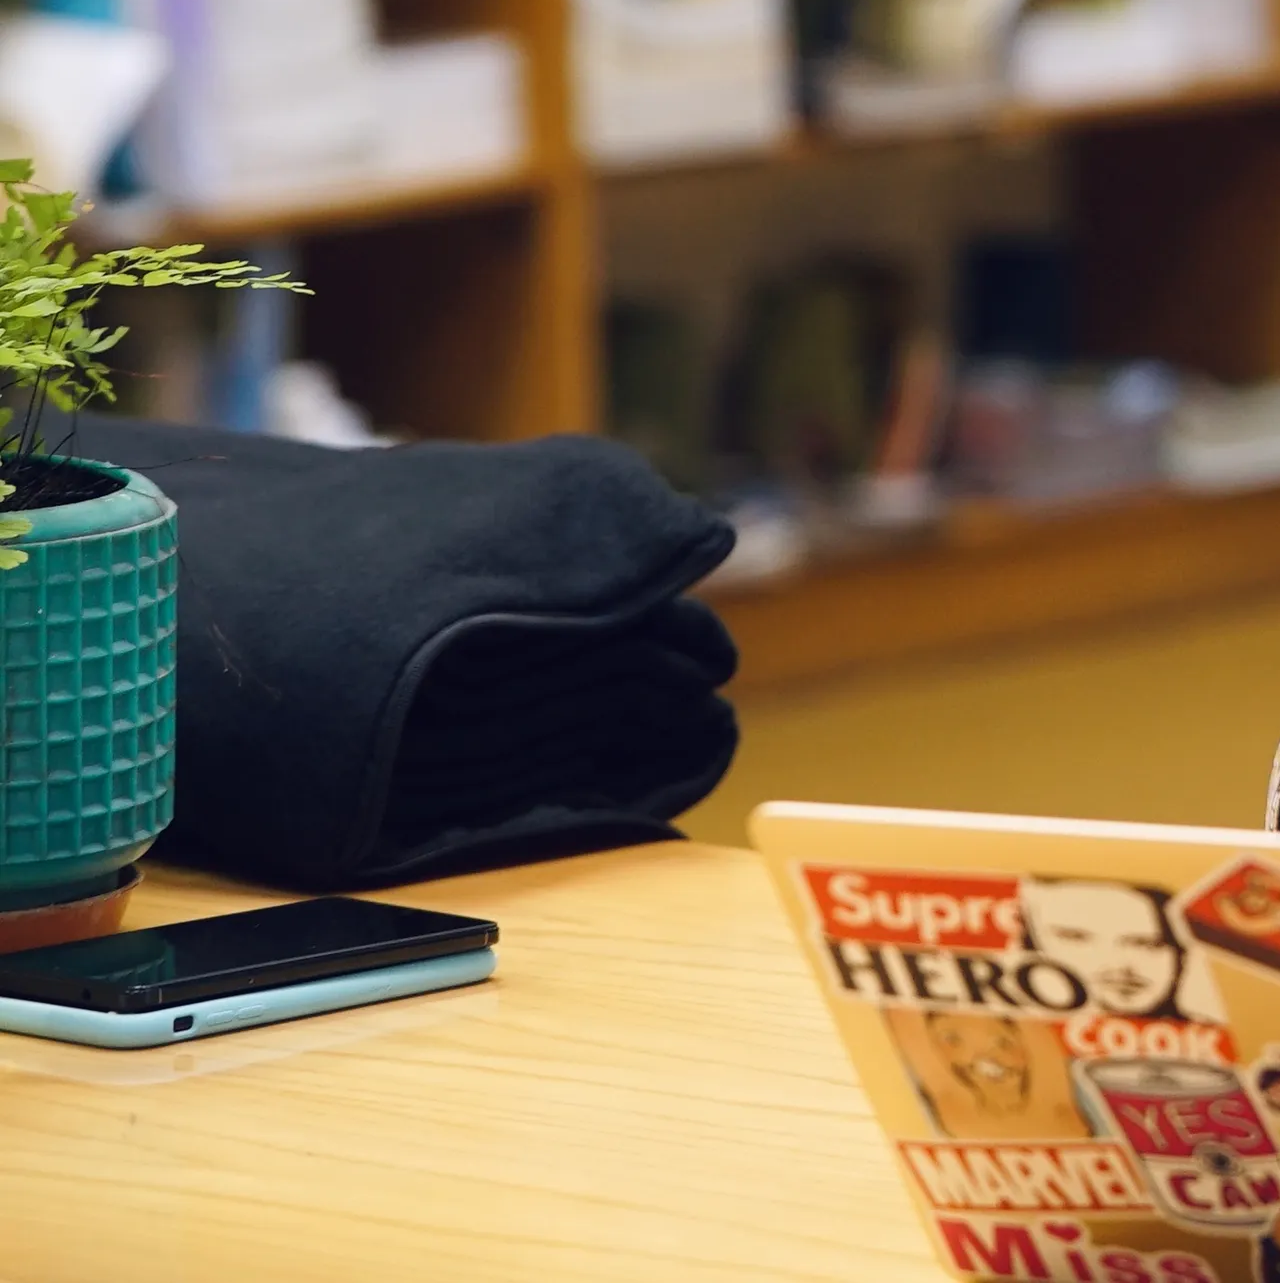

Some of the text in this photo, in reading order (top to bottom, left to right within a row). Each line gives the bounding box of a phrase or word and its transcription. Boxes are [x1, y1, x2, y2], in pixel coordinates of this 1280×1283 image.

[826, 941, 1088, 1010] HERO
[1064, 1016, 1230, 1064] COOK
[1118, 1099, 1264, 1150] YES
